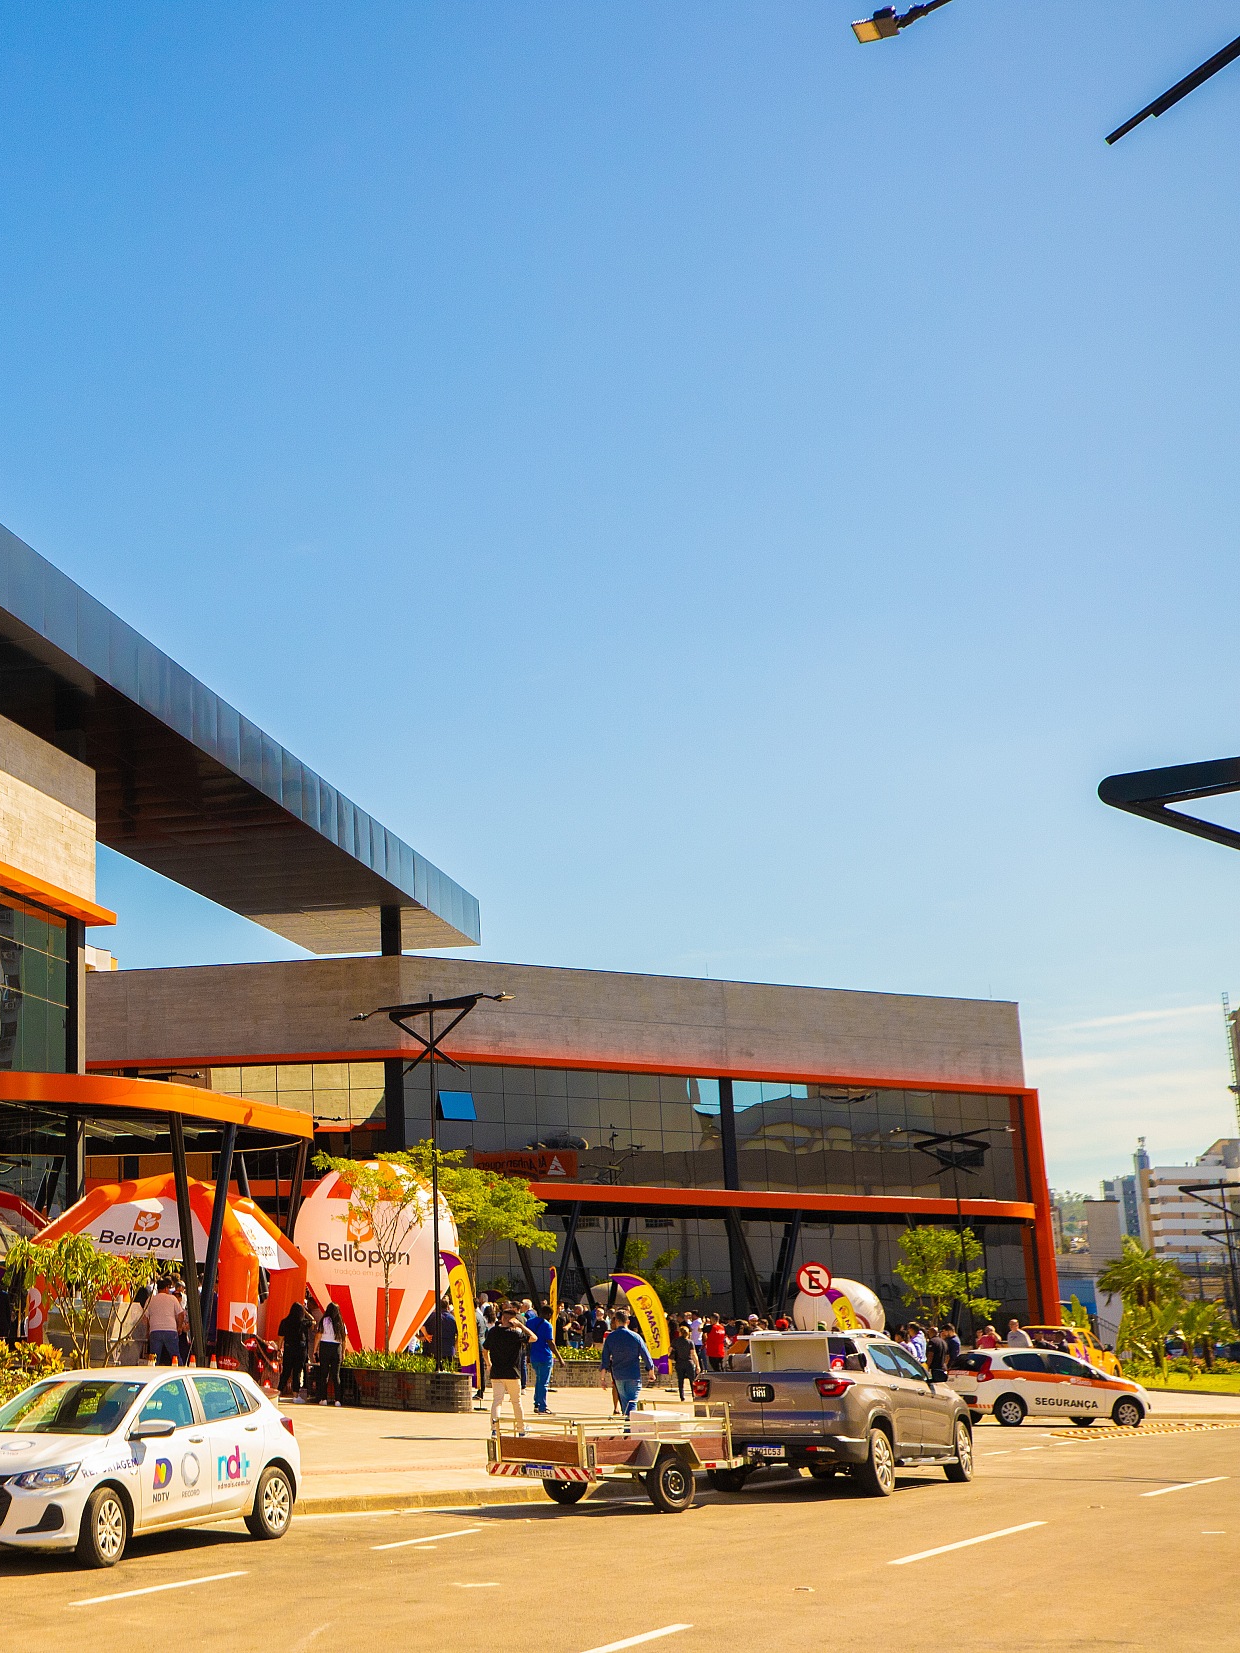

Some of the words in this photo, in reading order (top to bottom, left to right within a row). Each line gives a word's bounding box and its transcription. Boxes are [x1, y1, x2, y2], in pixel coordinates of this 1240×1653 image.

[317, 1242, 410, 1268] Bellopan
[334, 1268, 361, 1277] tradição
[808, 1270, 821, 1289] E
[459, 1300, 470, 1352] MASSA
[645, 1310, 660, 1349] MASSA
[1035, 1397, 1099, 1410] SEGURANÇA
[217, 1479, 251, 1490] ndmais.com.br
[153, 1491, 170, 1503] NDTV
[181, 1489, 200, 1498] RECORD
